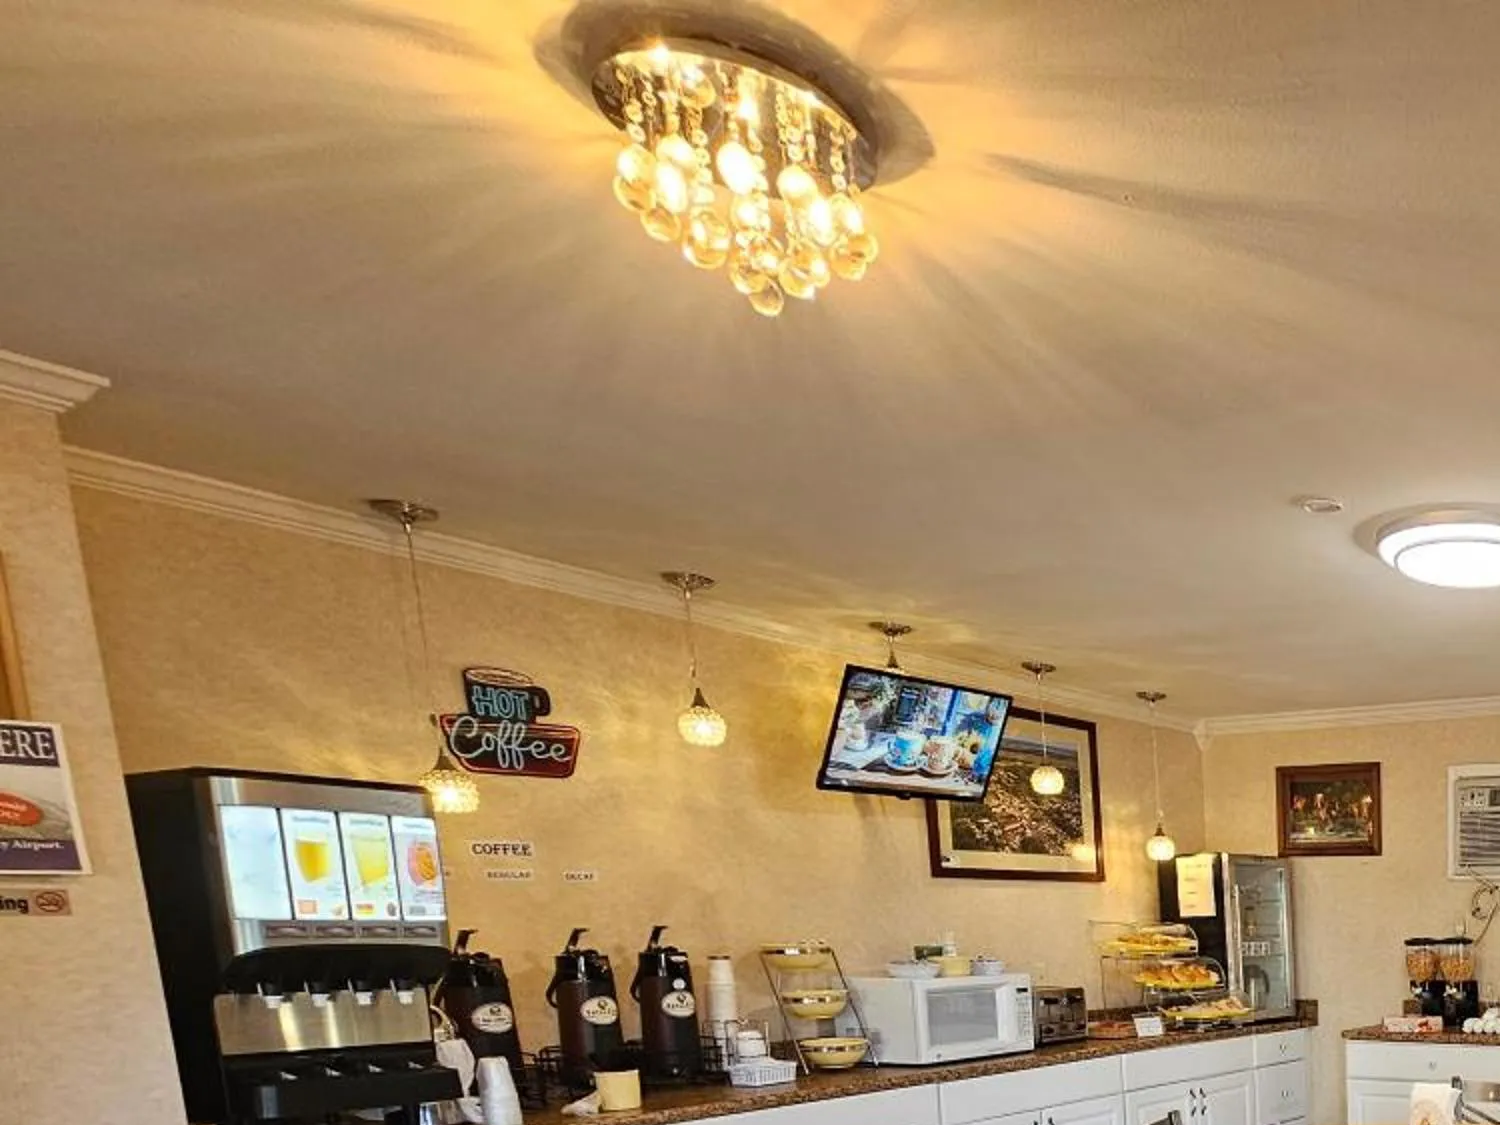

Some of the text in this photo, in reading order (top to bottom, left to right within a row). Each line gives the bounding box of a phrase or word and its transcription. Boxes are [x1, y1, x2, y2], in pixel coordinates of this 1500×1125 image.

[472, 685, 529, 720] HOT
[0, 729, 56, 759] ERE
[451, 715, 574, 770] Coffee
[472, 843, 532, 856] COFFEE
